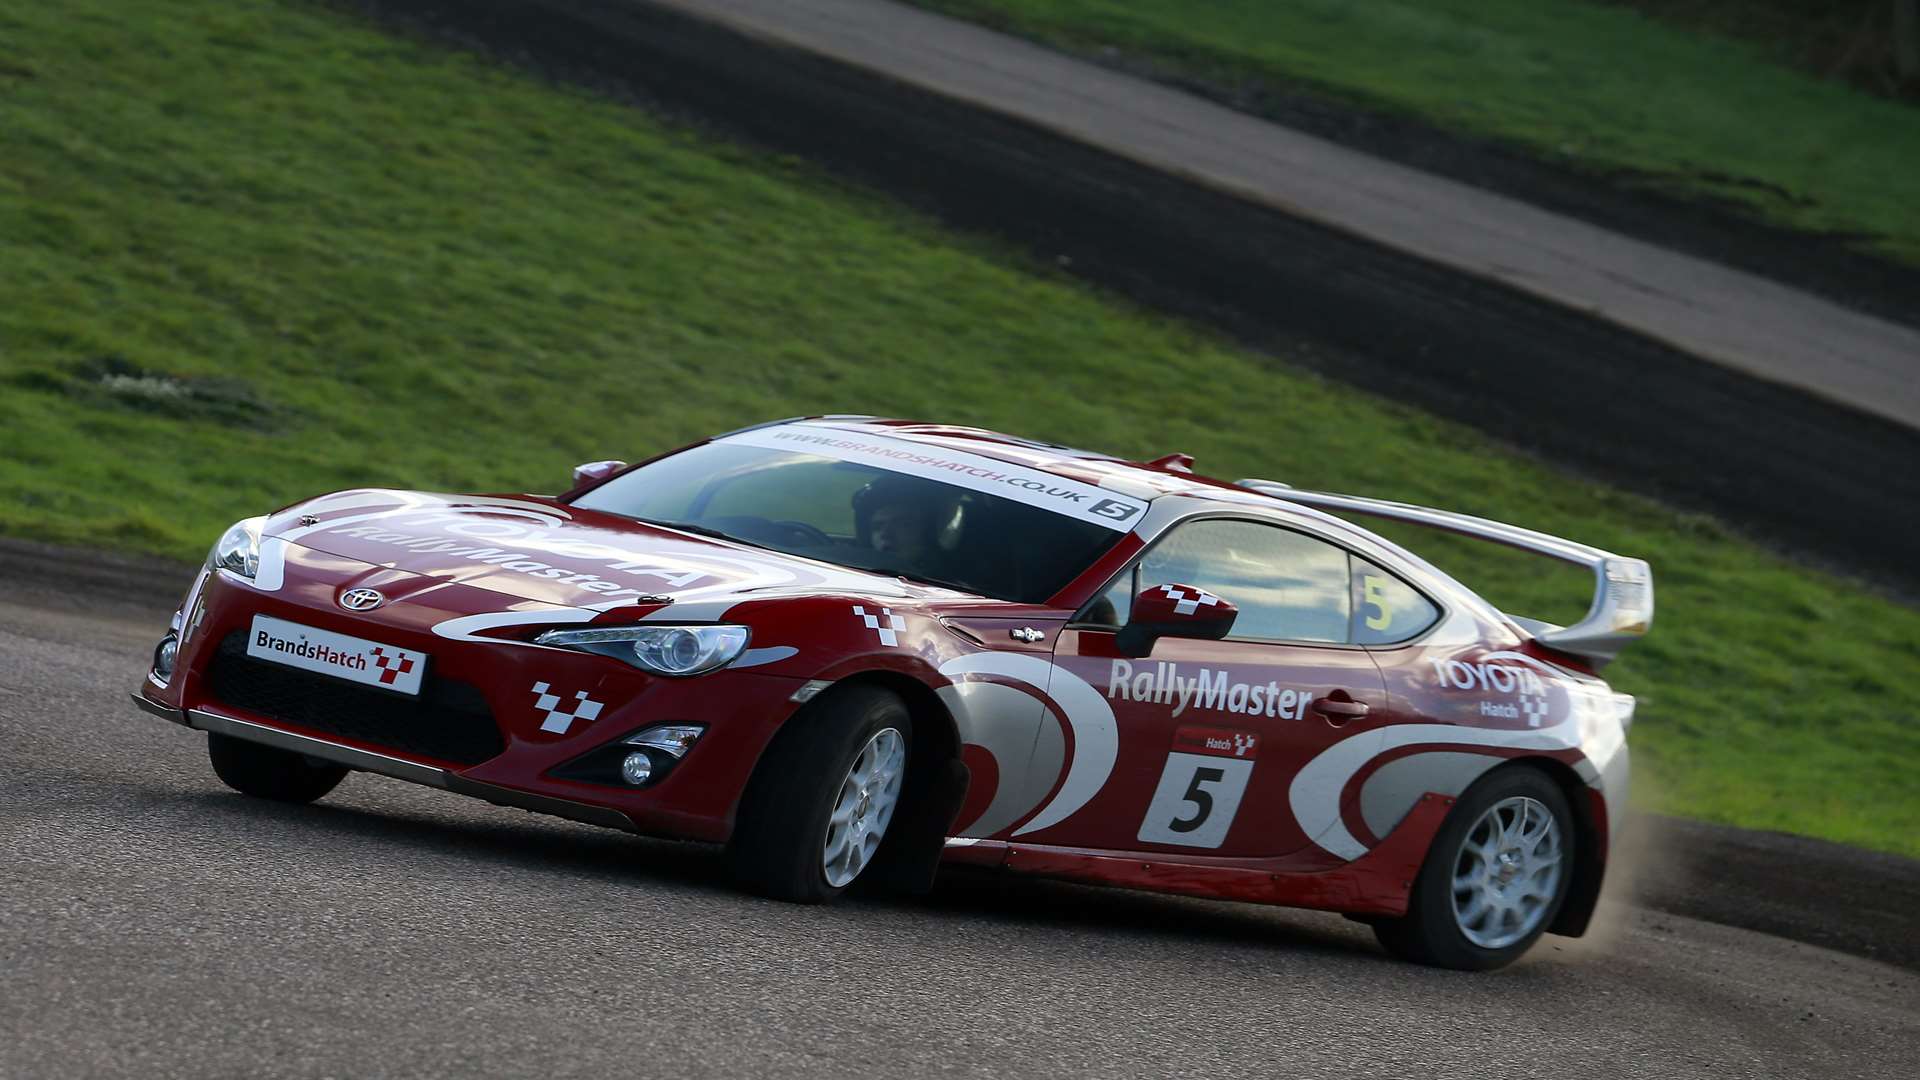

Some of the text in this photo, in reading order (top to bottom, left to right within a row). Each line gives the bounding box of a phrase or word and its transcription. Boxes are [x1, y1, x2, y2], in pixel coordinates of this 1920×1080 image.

[330, 526, 646, 597] RallyMaster
[1364, 575, 1392, 631] 5
[256, 630, 367, 671] BrandsHatch
[1107, 658, 1313, 721] RallyMaster
[1427, 655, 1547, 697] TOYOTA
[1479, 701, 1519, 719] Hatch
[1206, 737, 1232, 751] Hatch
[1167, 766, 1225, 833] 5
